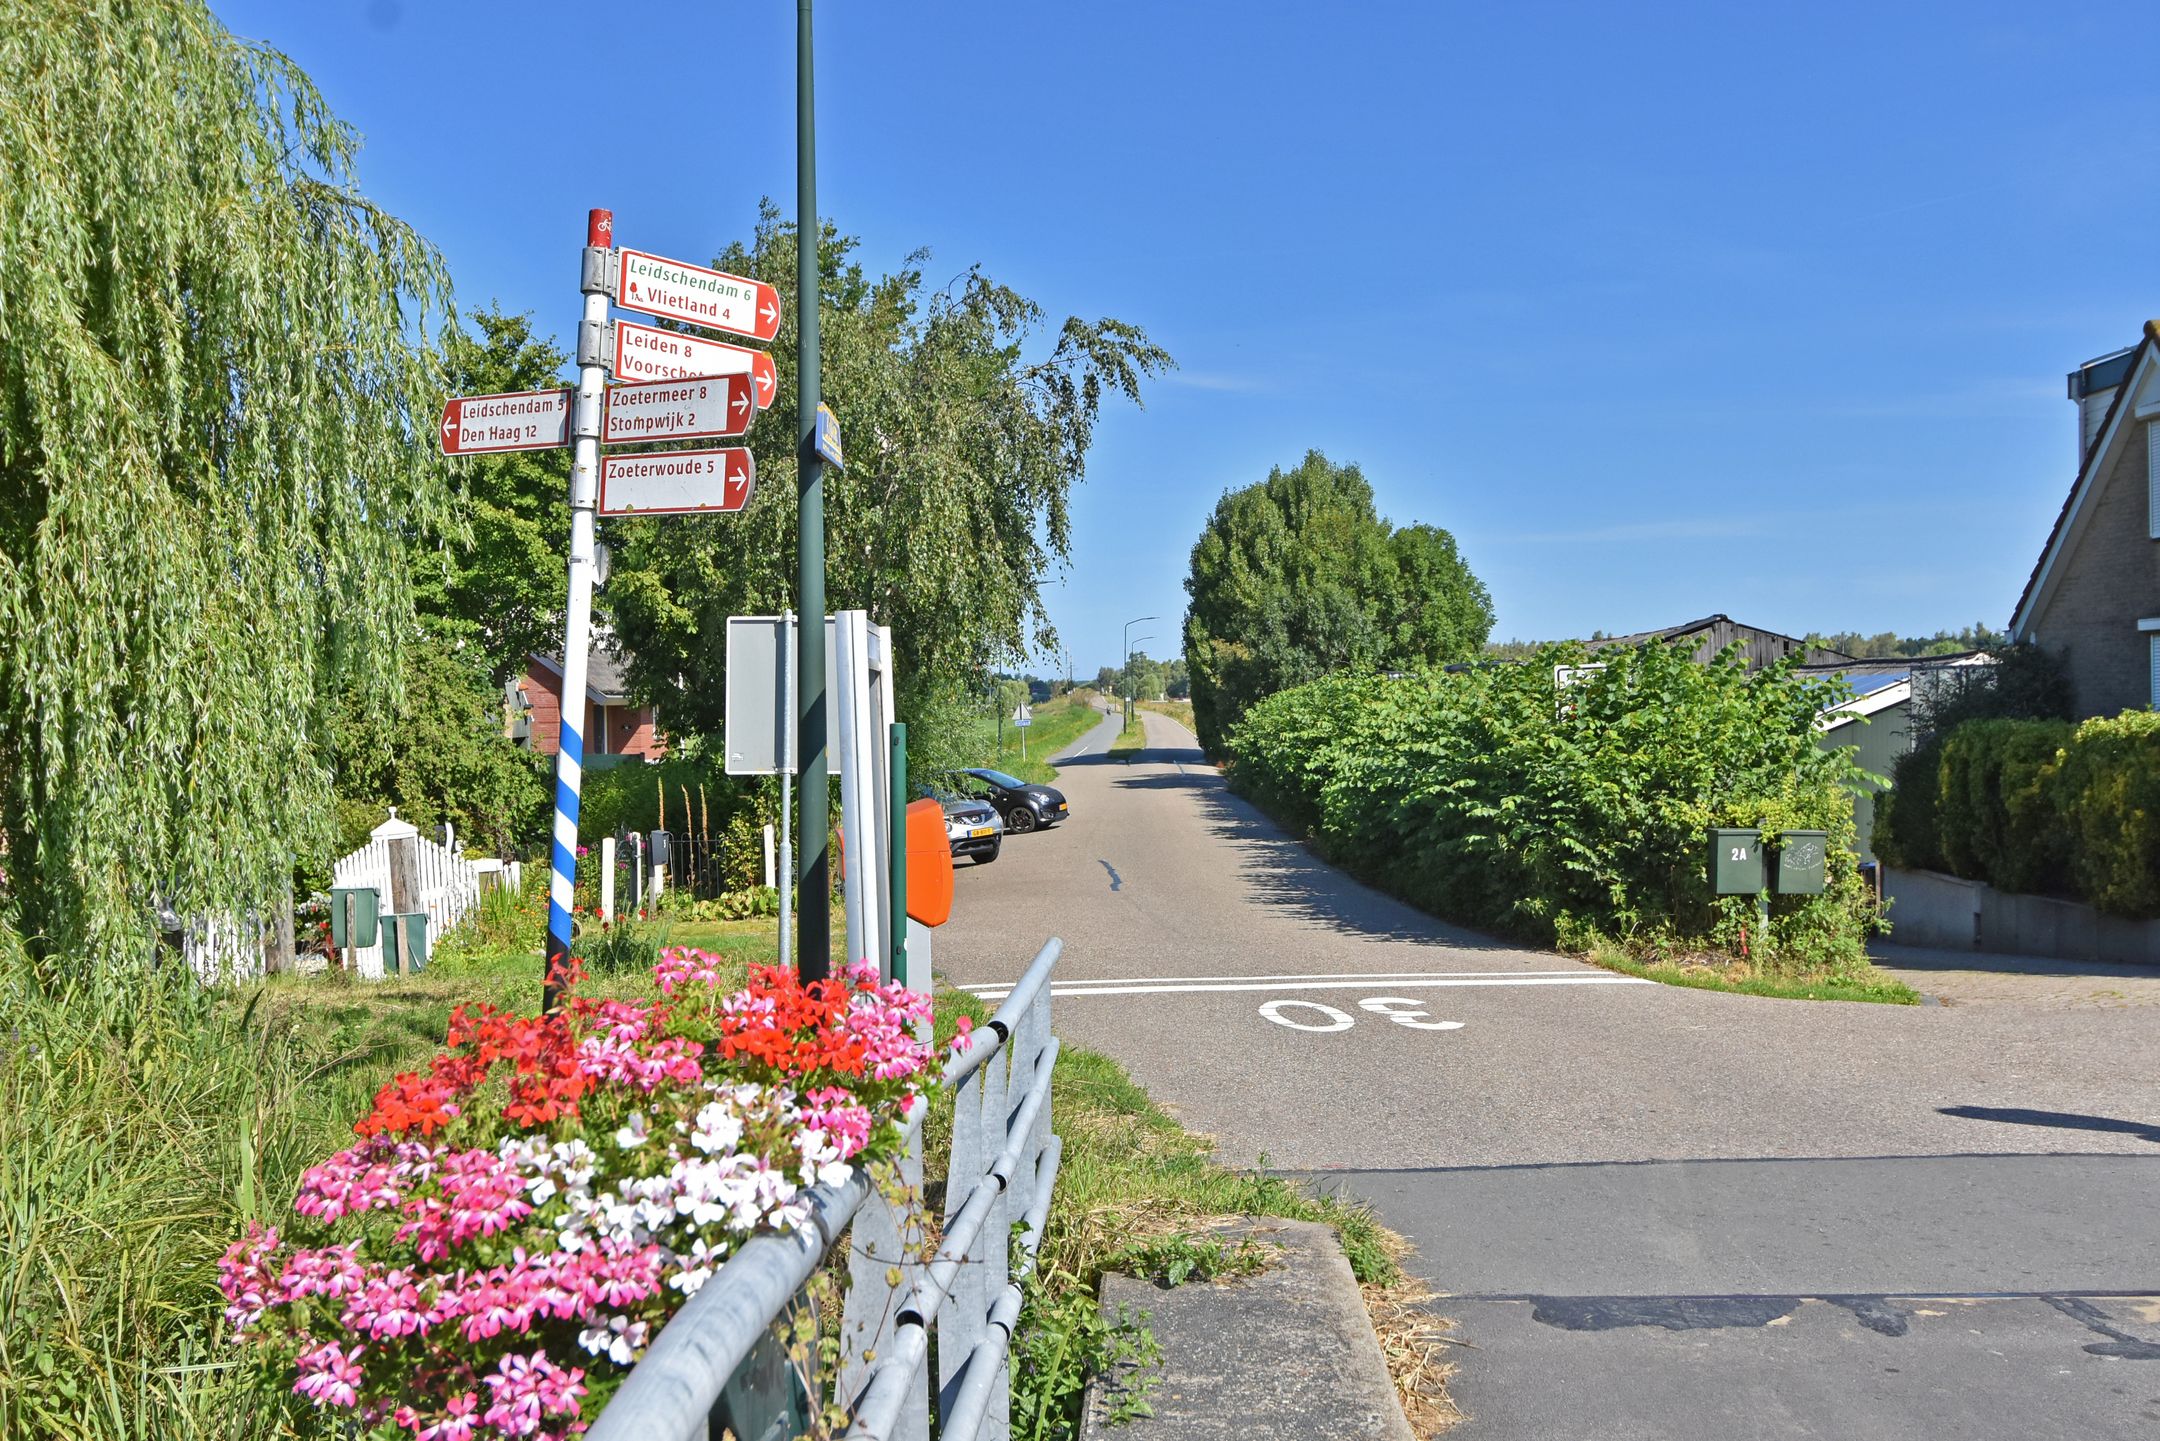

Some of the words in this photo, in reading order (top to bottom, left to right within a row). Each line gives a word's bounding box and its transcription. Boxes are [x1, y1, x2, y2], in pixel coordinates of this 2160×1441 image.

[630, 258, 739, 298] Leidschendam
[743, 289, 752, 301] 6
[647, 286, 717, 317] Vlietland
[722, 308, 731, 320] 4
[625, 330, 678, 355] Leiden
[684, 345, 692, 358] 8
[612, 388, 695, 407] Zoetermeer
[699, 386, 707, 399] 8
[463, 399, 553, 419] Leidschendam
[557, 398, 564, 411] 5
[610, 411, 684, 433] Stompwijk
[688, 413, 695, 426] 2
[461, 428, 485, 443] Den
[489, 426, 521, 443] Haag
[525, 425, 537, 438] 12
[608, 459, 702, 479] Zoeterwoude
[707, 460, 714, 473] 5
[1731, 847, 1747, 861] 2A
[1258, 997, 1466, 1033] 30
